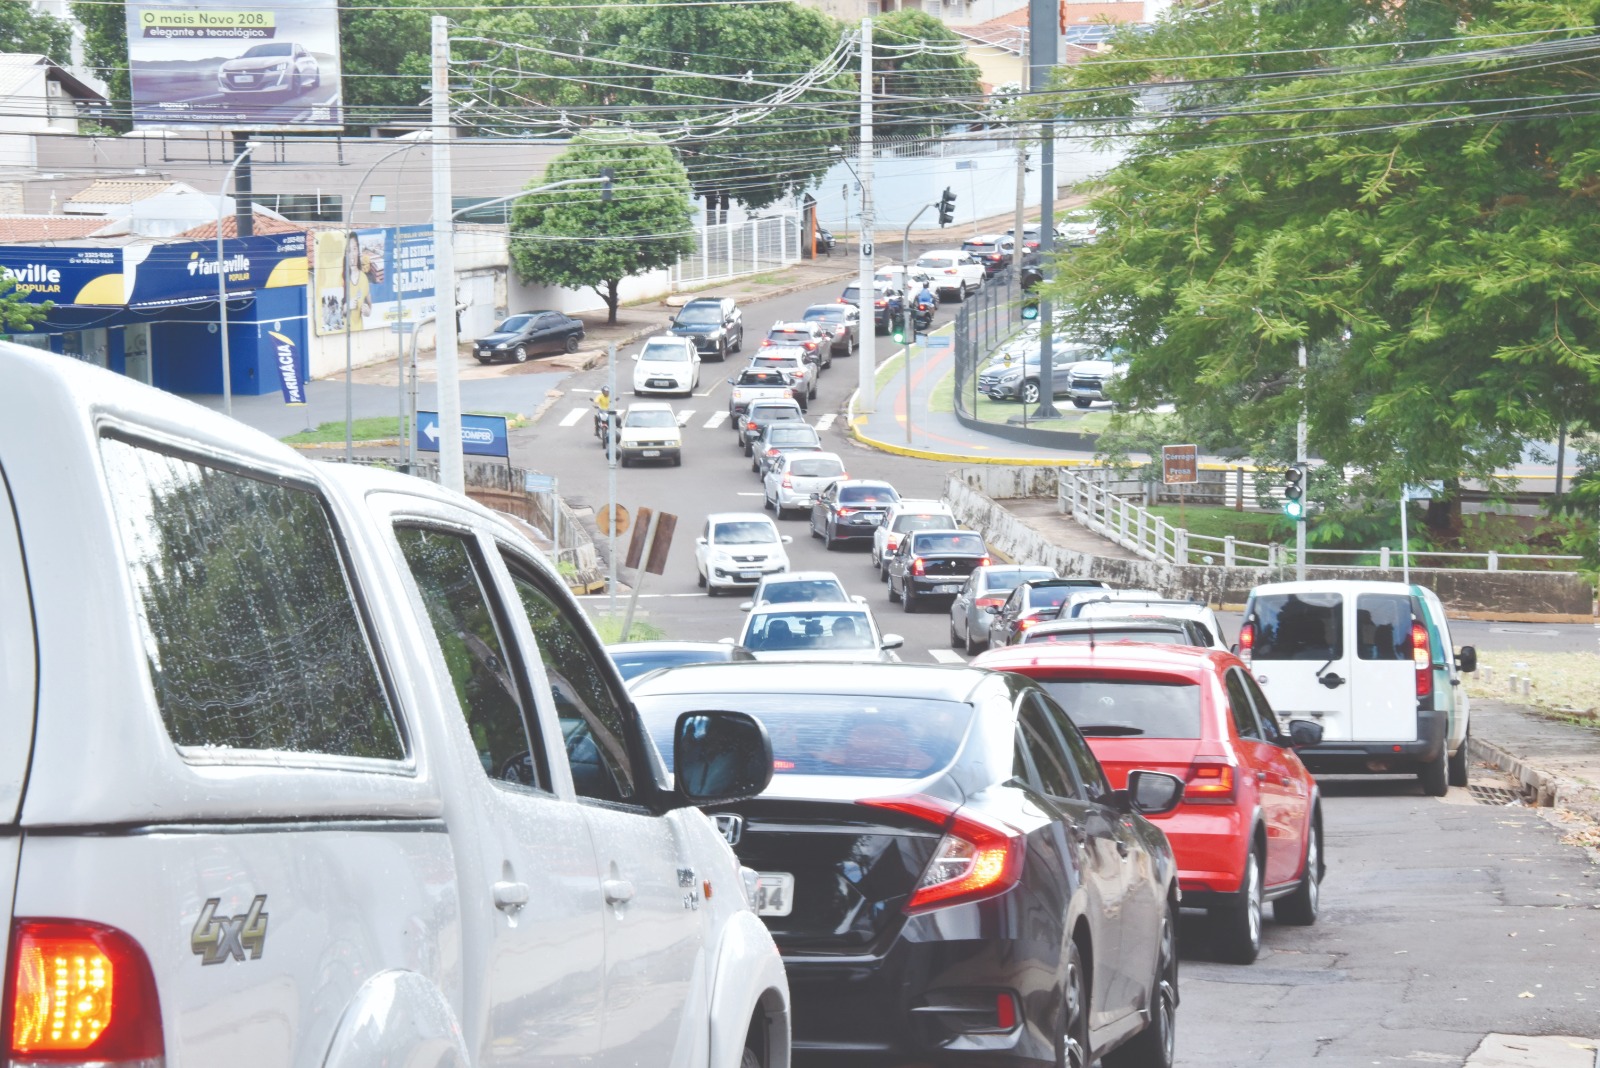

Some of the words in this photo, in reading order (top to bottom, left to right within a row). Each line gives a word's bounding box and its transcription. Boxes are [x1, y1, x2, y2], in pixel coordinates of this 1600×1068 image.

[143, 12, 155, 23] O
[160, 13, 195, 24] mais
[199, 13, 234, 24] Novo
[238, 13, 268, 26] 208,
[149, 26, 195, 38] elegante
[196, 28, 204, 36] e
[205, 27, 268, 39] tecnológico.
[228, 273, 250, 281] POPULAR
[15, 284, 61, 293] POPULAR
[277, 345, 301, 402] FARMÁCIA
[191, 894, 269, 966] 4x4
